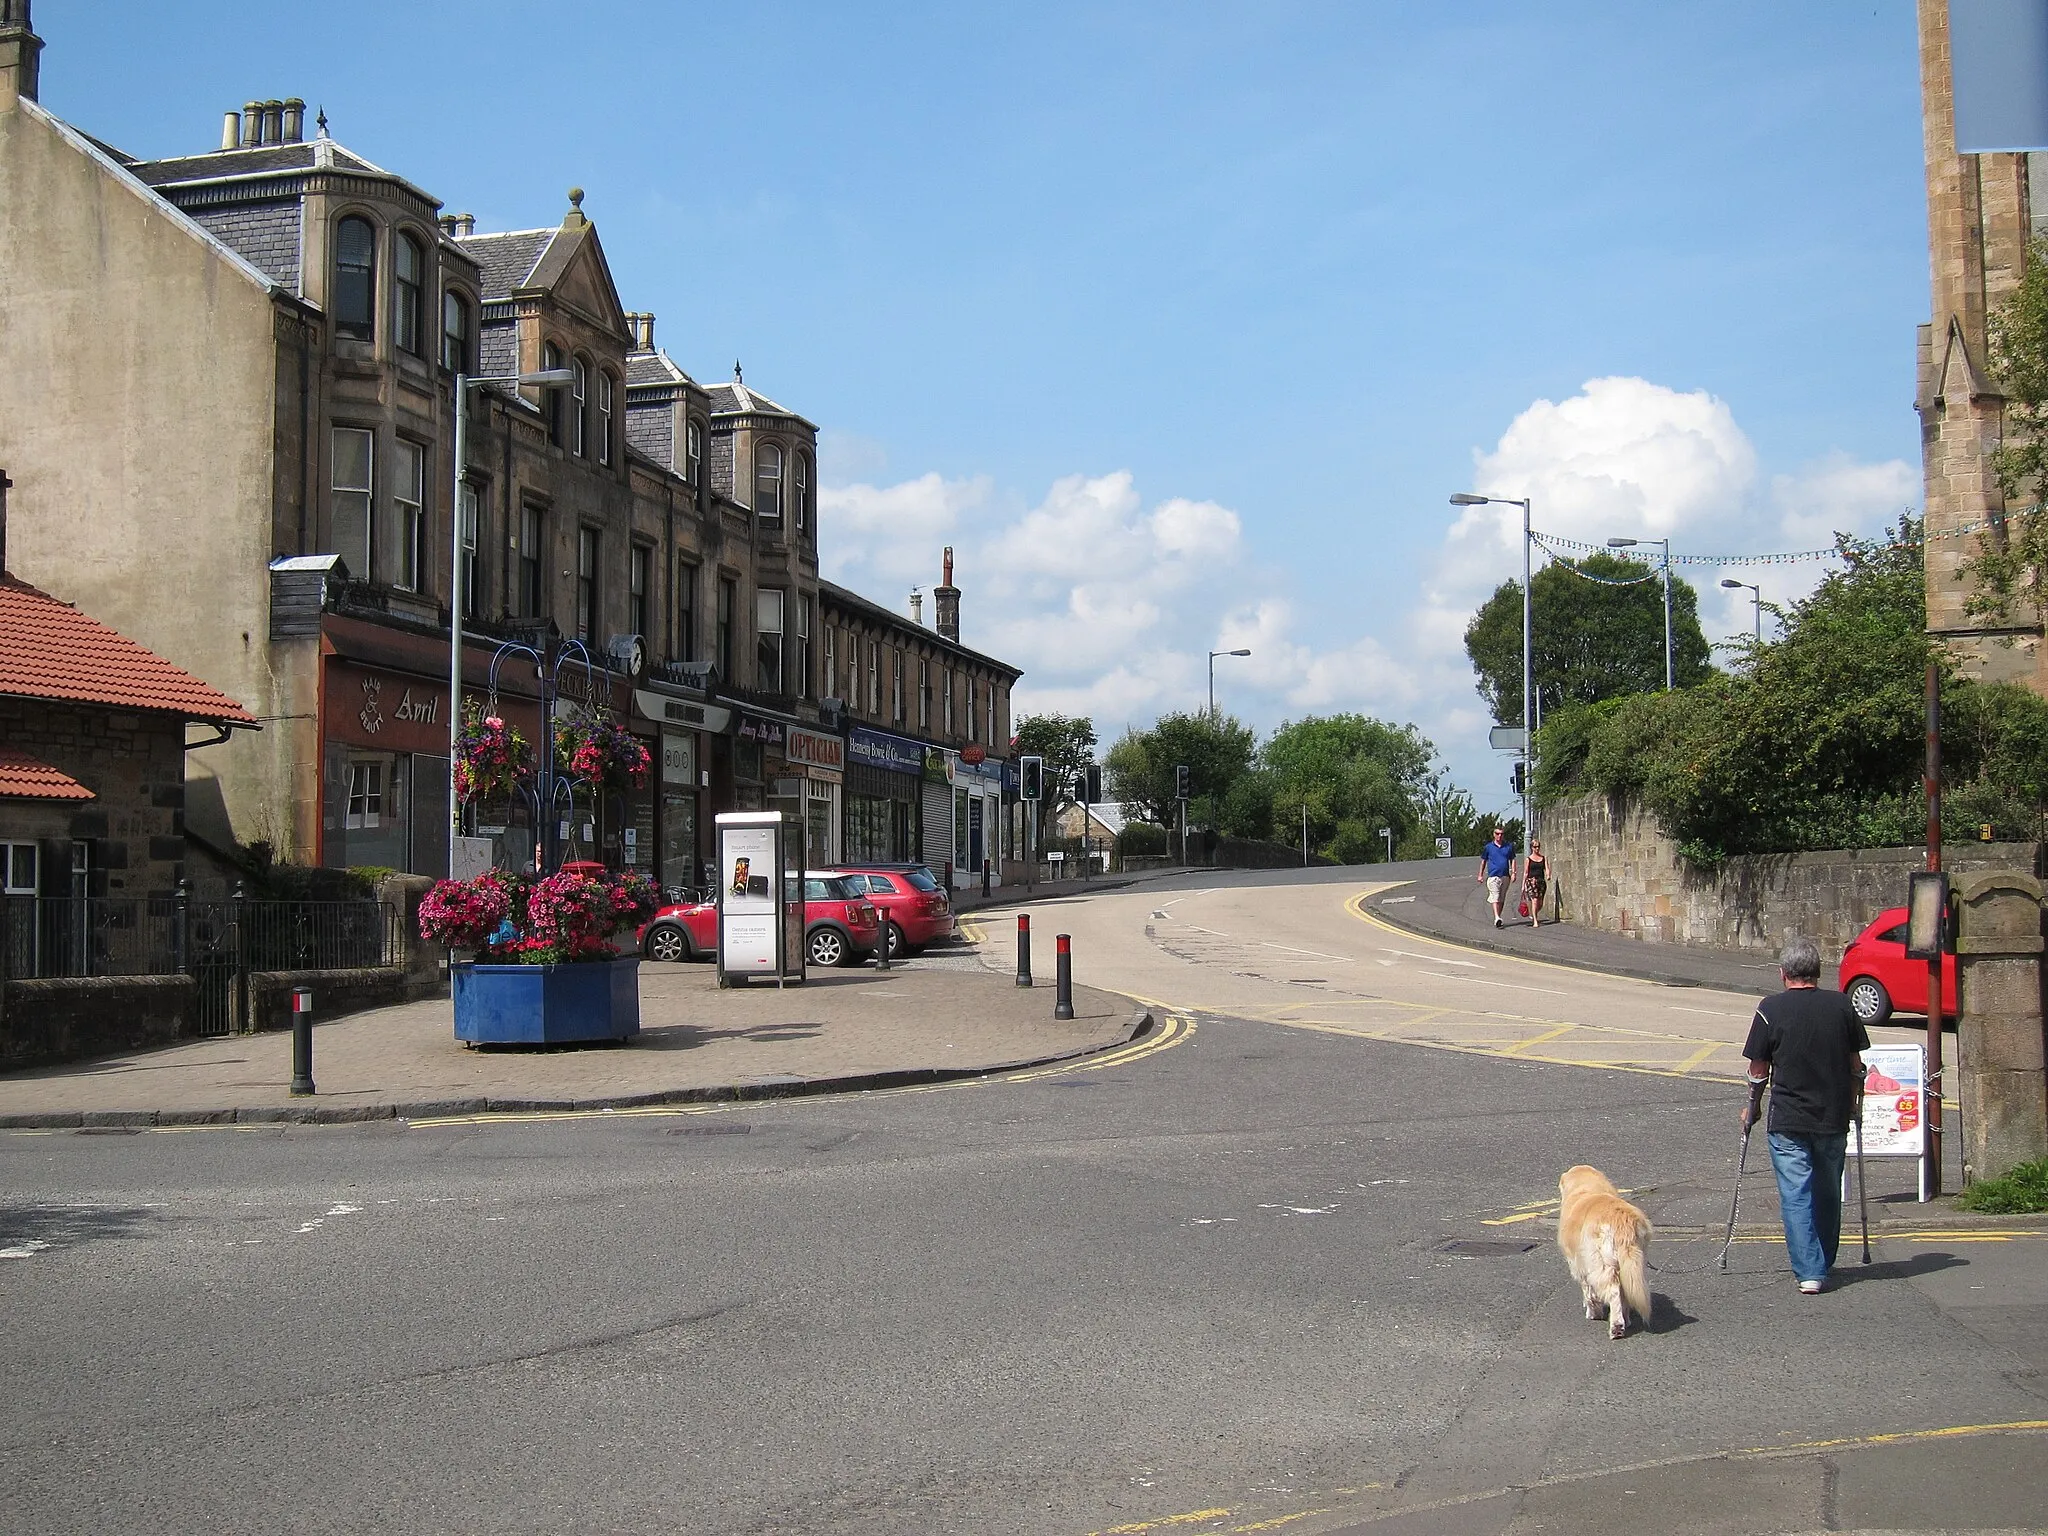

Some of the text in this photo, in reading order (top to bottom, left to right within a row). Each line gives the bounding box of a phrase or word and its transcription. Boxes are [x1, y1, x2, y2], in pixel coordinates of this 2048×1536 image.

[362, 677, 381, 694] HAIR
[366, 695, 379, 713] &
[360, 710, 384, 734] BEAUTY
[789, 732, 841, 765] OPTICIAN
[1899, 1101, 1913, 1110] £5
